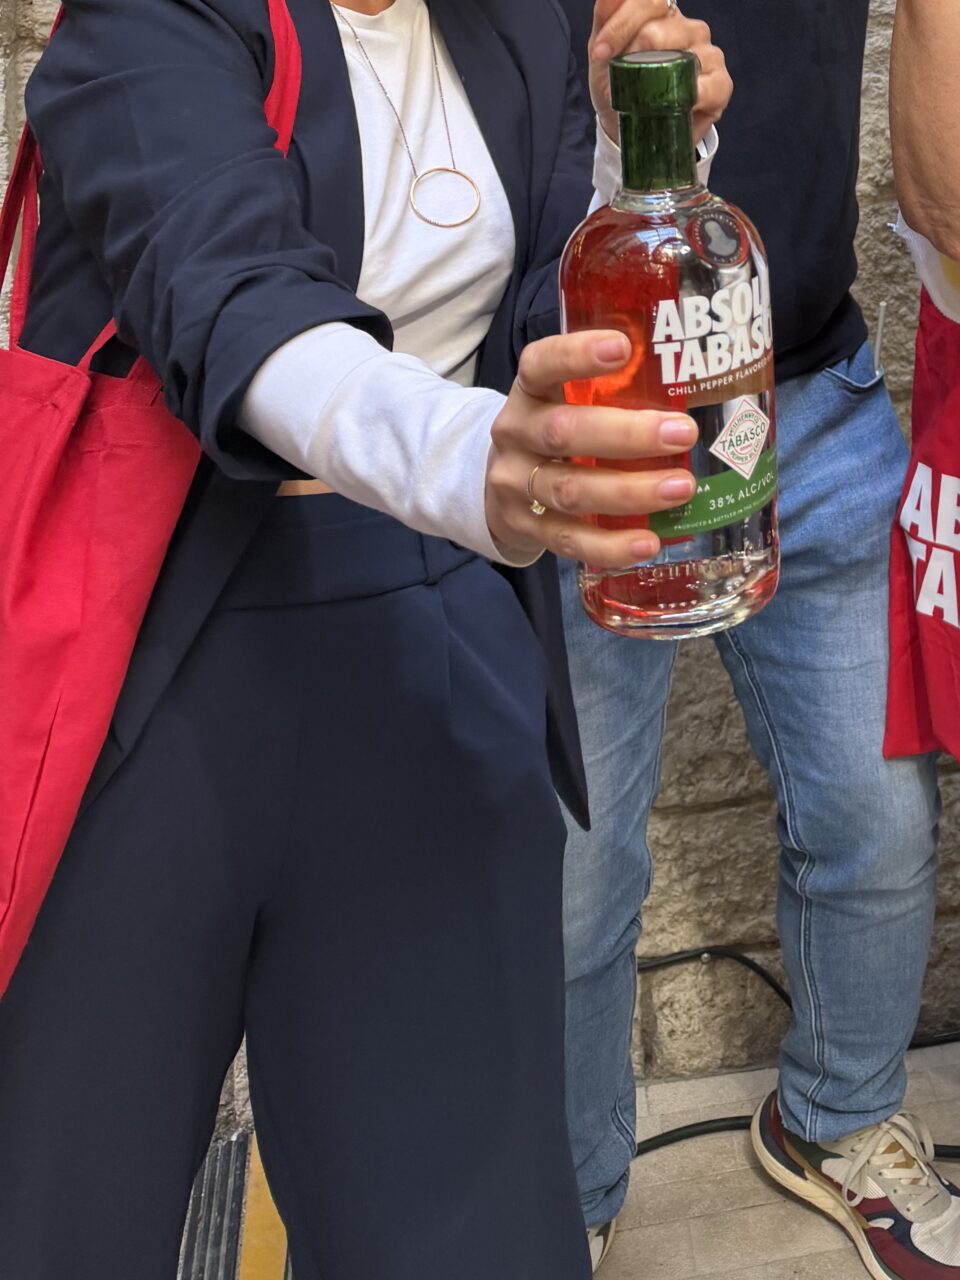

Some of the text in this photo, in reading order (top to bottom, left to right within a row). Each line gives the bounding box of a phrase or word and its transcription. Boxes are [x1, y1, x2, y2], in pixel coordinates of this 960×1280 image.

[668, 384, 697, 397] CHILI
[700, 375, 734, 392] PEPPER
[720, 421, 766, 452] TABASCO
[709, 493, 736, 511] 38%
